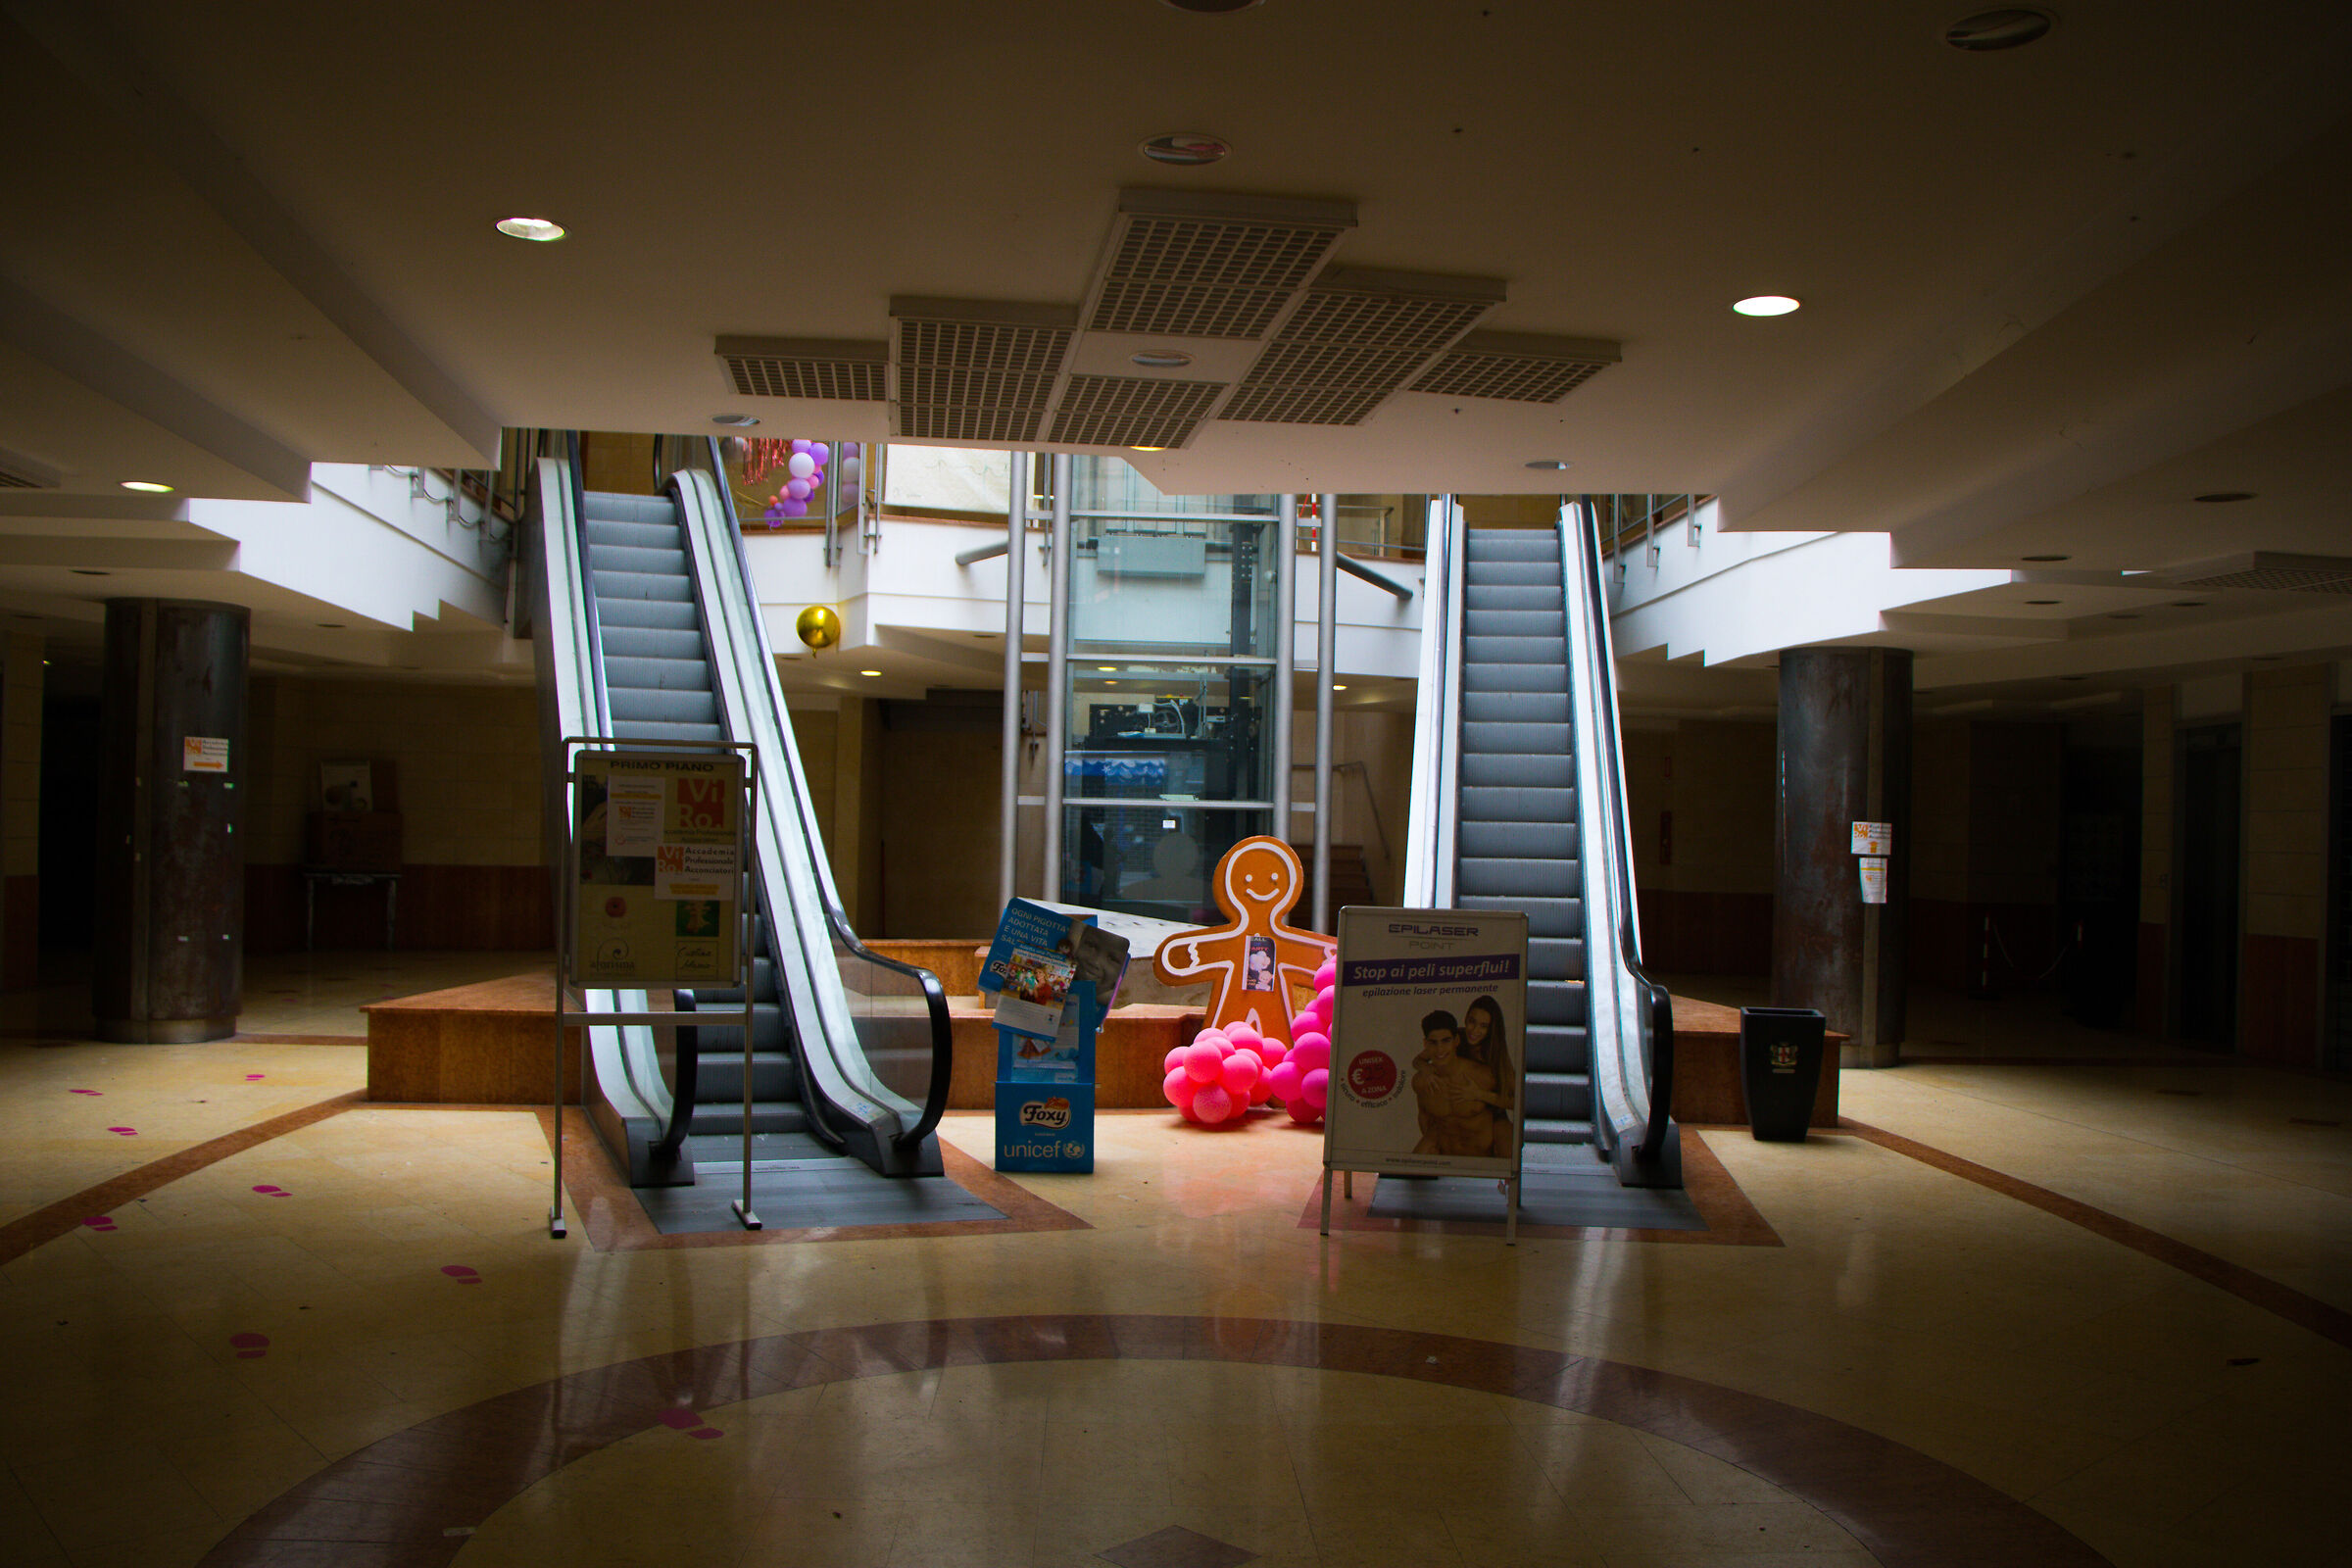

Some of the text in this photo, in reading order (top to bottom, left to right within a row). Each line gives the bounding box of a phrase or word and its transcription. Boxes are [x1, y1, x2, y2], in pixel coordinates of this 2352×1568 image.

[610, 760, 714, 772] PRIMO PIANO
[687, 778, 718, 804] Vi
[685, 847, 734, 856] Accademia
[685, 857, 734, 865] Professionale
[684, 865, 734, 874] Acconciatori
[1011, 907, 1032, 919] OGNI
[1007, 916, 1049, 937] ADOTTATA
[1389, 924, 1479, 937] EPILASER
[1001, 934, 1017, 946] SAL
[1011, 927, 1028, 940] UNA
[1031, 935, 1048, 947] VITA
[1408, 941, 1455, 950] POINT
[993, 961, 1006, 974] Fo
[1352, 959, 1511, 982] Stop ai peli superflui!
[1362, 984, 1498, 999] epilazione laser permanente
[1023, 1104, 1066, 1126] Foxy
[1004, 1140, 1061, 1158] unicef
